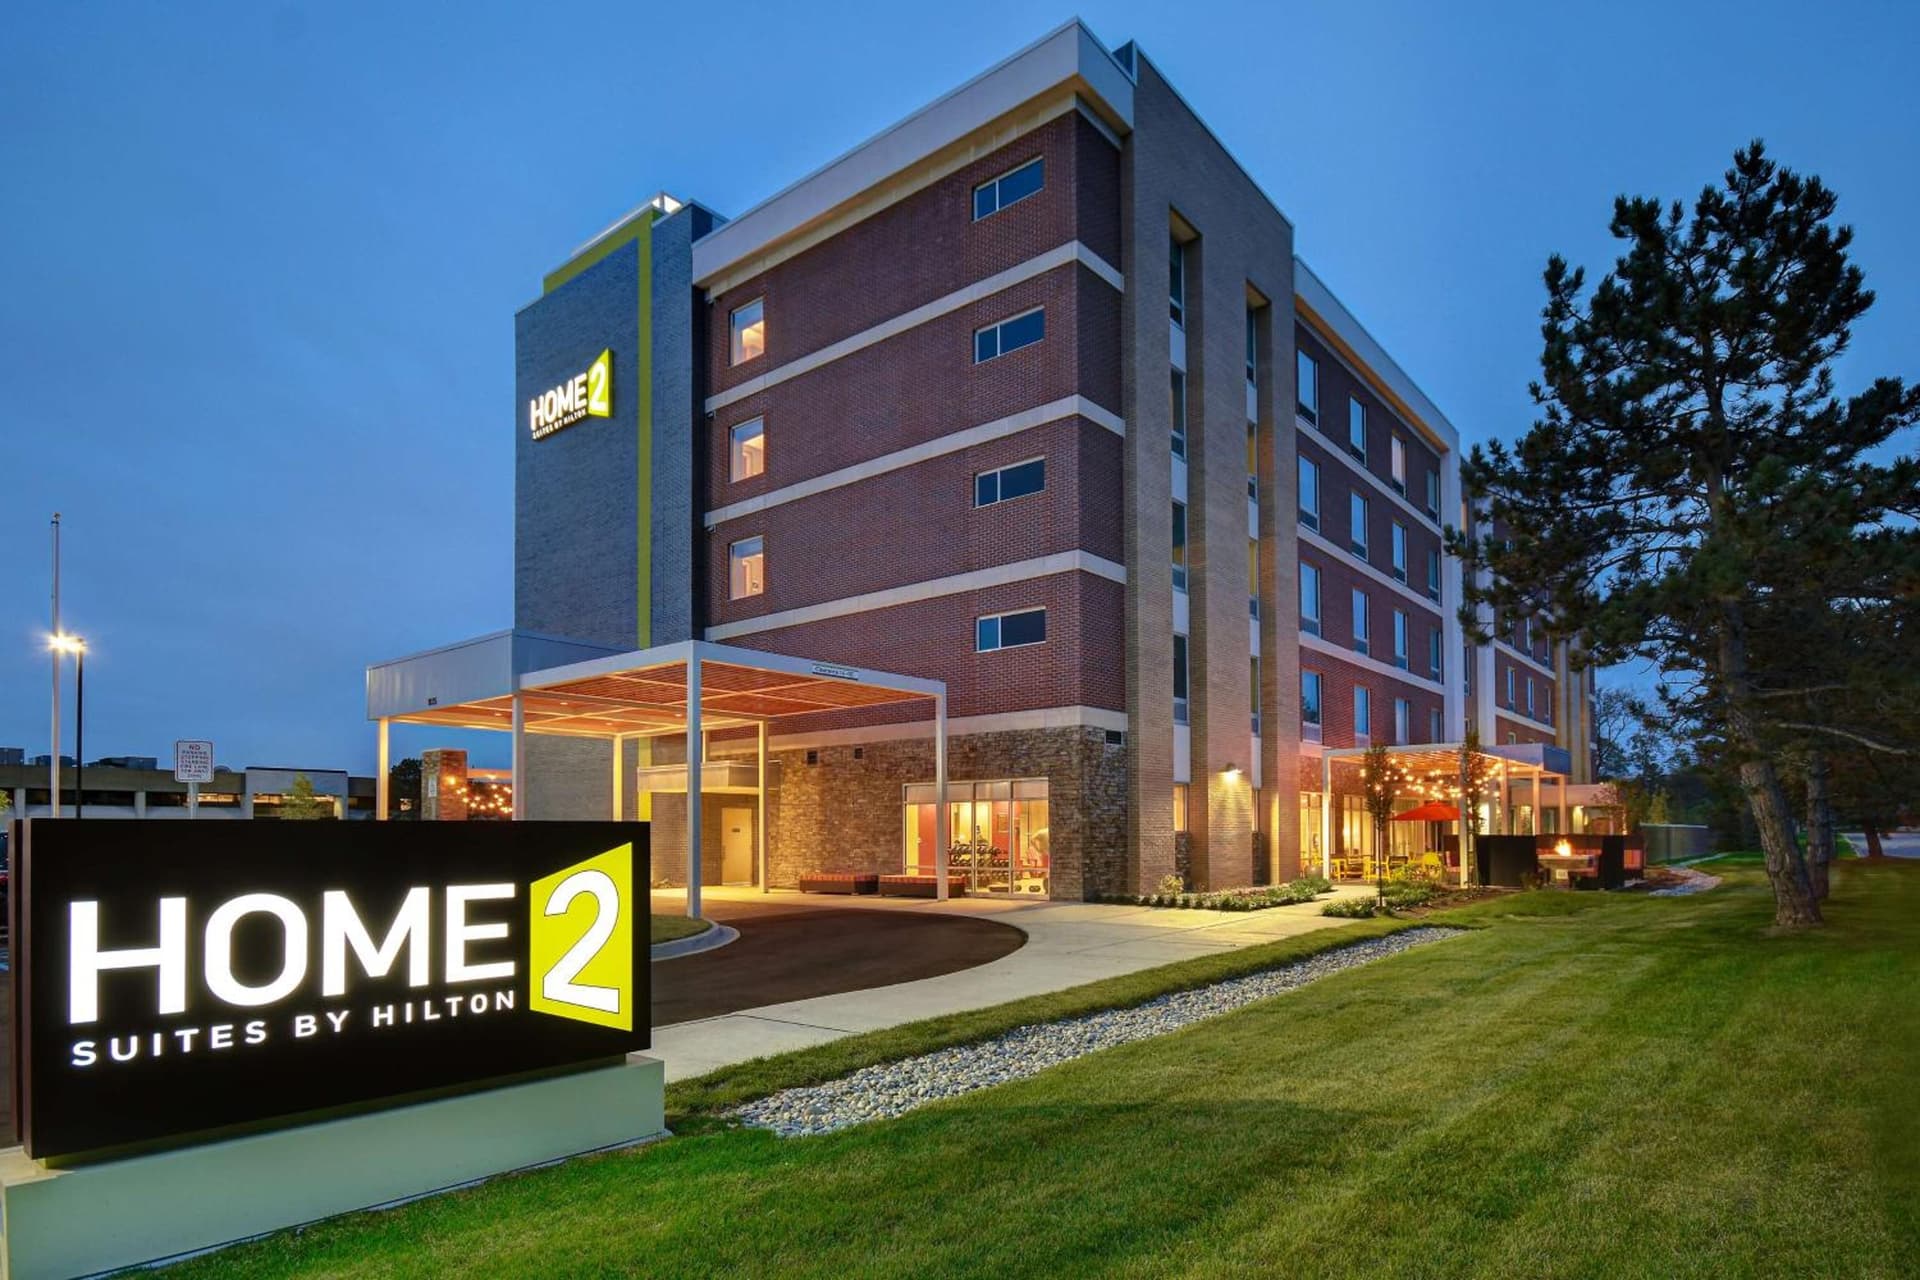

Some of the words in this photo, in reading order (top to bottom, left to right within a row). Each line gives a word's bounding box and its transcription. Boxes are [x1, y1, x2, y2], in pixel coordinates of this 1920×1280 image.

[530, 372, 587, 431] HOME
[589, 361, 608, 412] 2
[70, 883, 516, 1024] HOME
[543, 869, 620, 1014] 2
[72, 1021, 267, 1066] SUITES
[295, 1011, 349, 1038] BY
[373, 990, 516, 1028] HILTON
